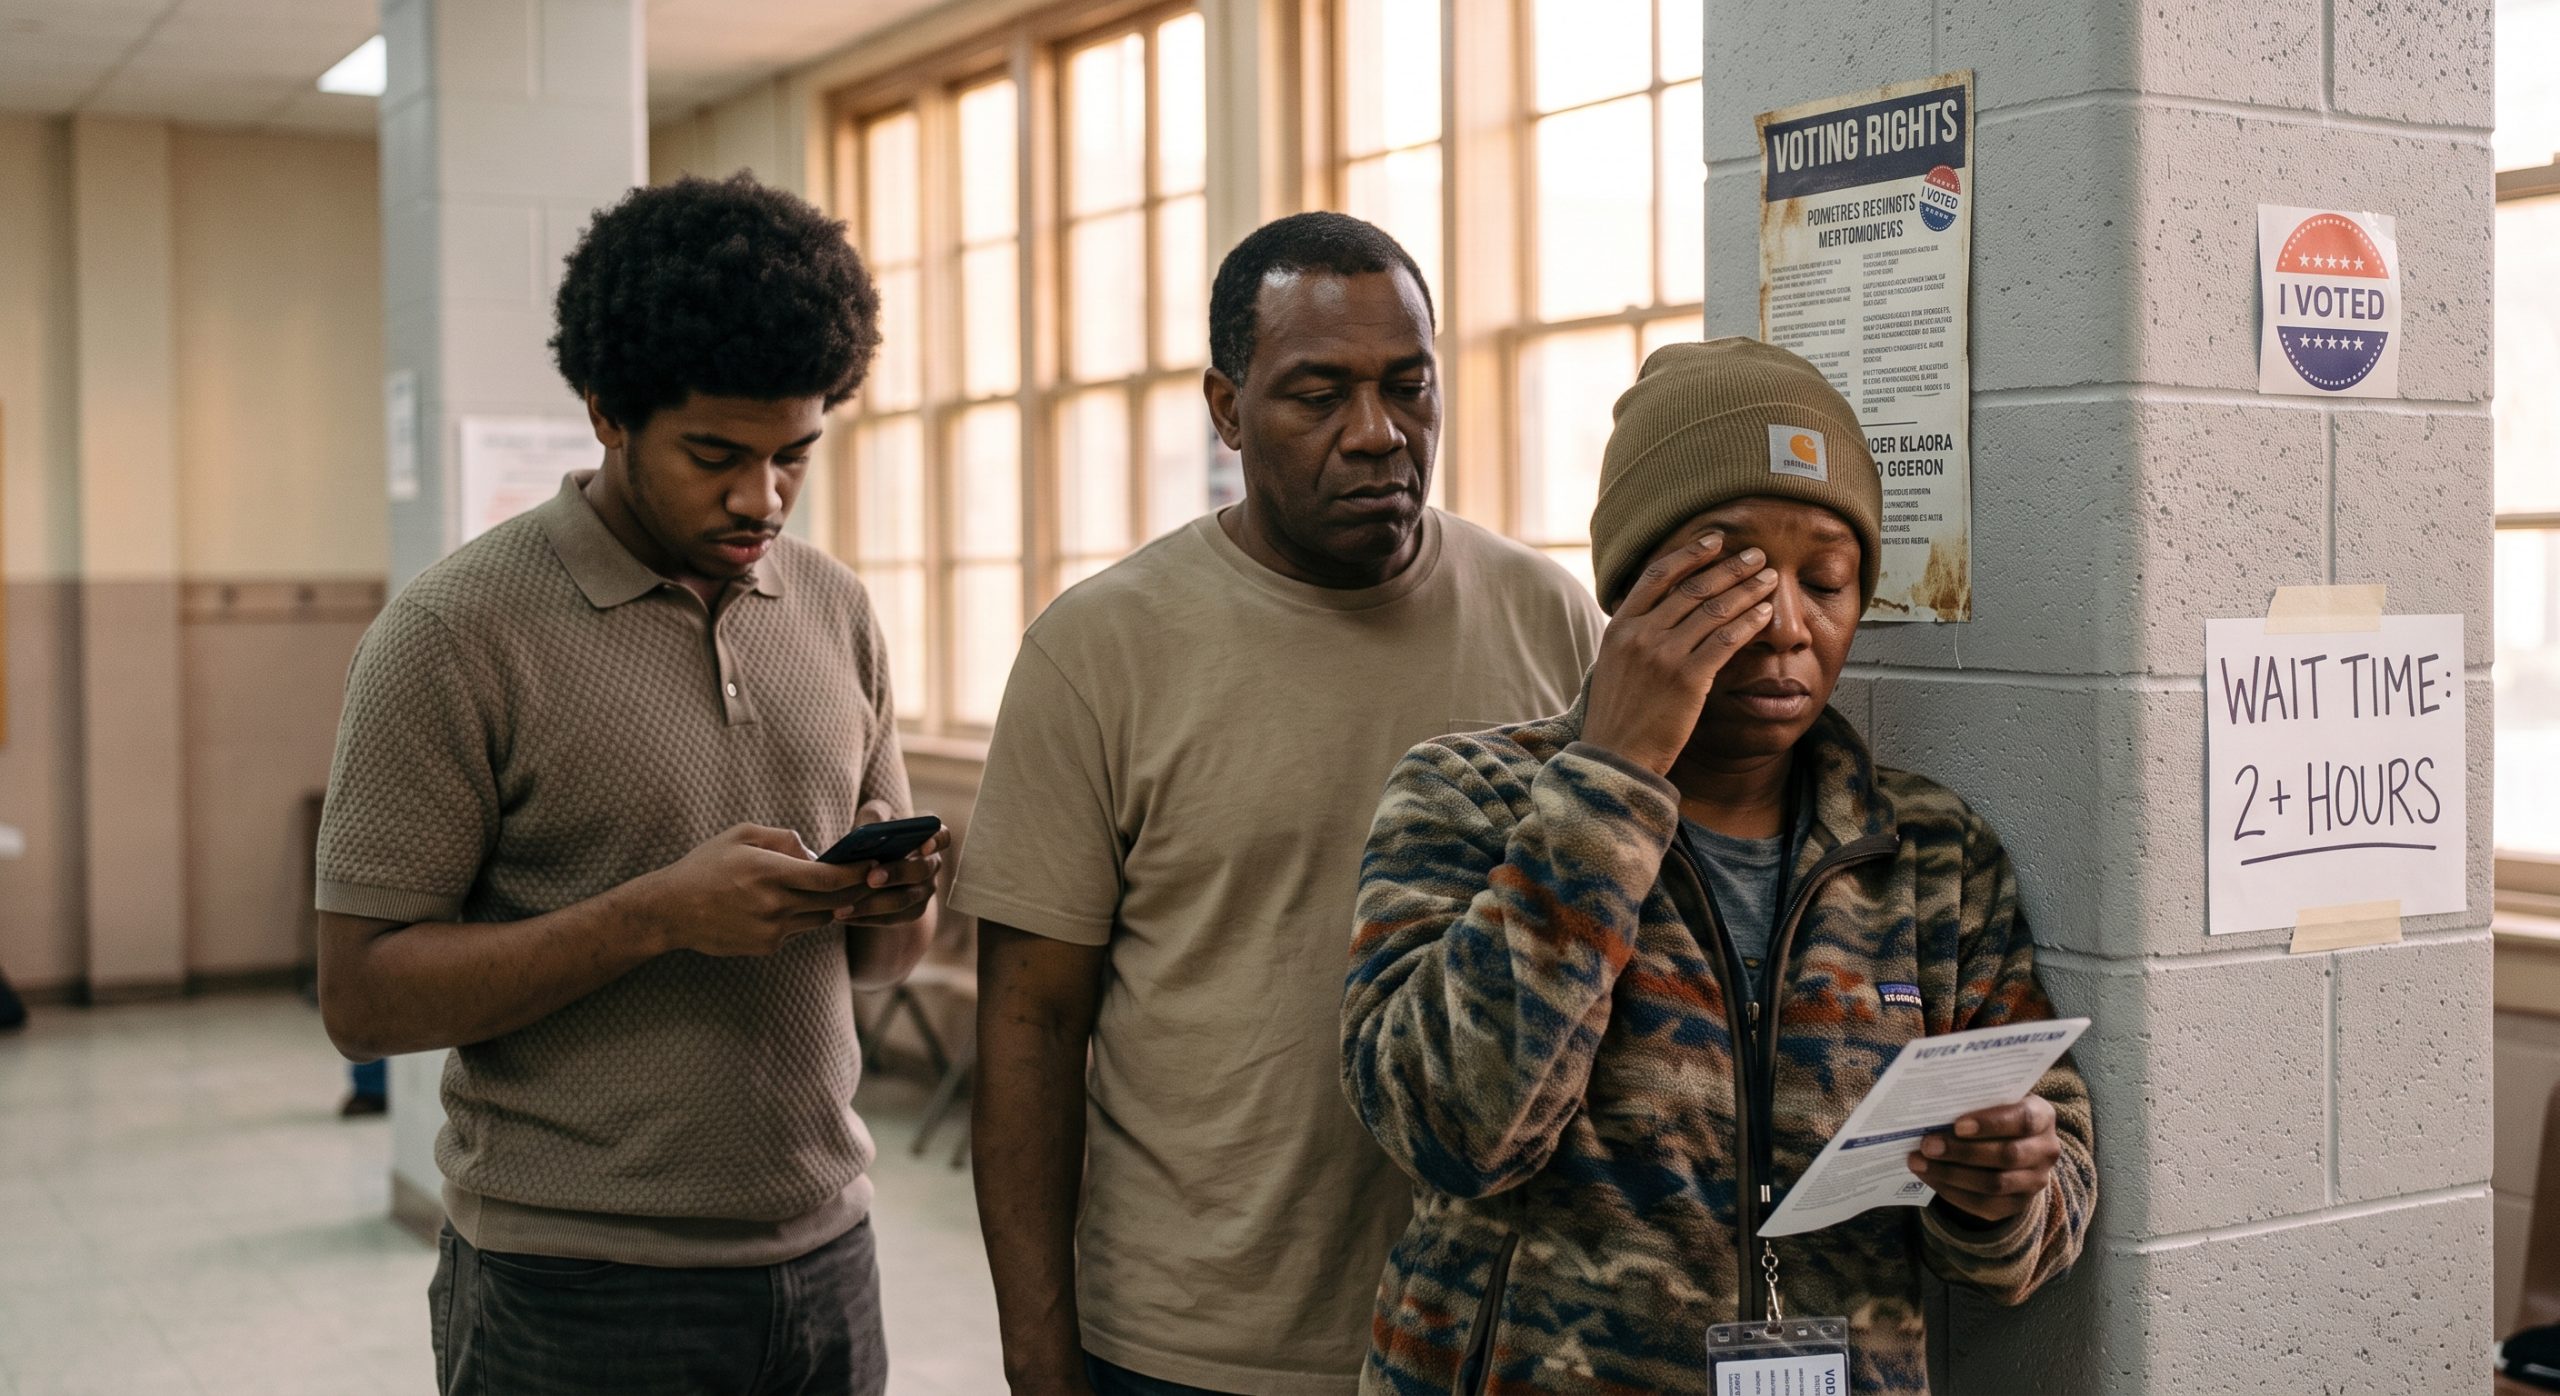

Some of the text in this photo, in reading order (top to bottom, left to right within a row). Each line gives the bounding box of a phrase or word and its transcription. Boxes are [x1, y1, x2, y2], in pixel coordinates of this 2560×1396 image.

[1773, 99, 1958, 174] VOTING RIGHTS
[1921, 186, 1958, 210] I VOTED
[2279, 283, 2385, 320] I VOTED
[1888, 458, 1944, 478] GGERON
[2220, 653, 2451, 725] WAIT TIME:
[2234, 757, 2441, 842] 2+ HOURS
